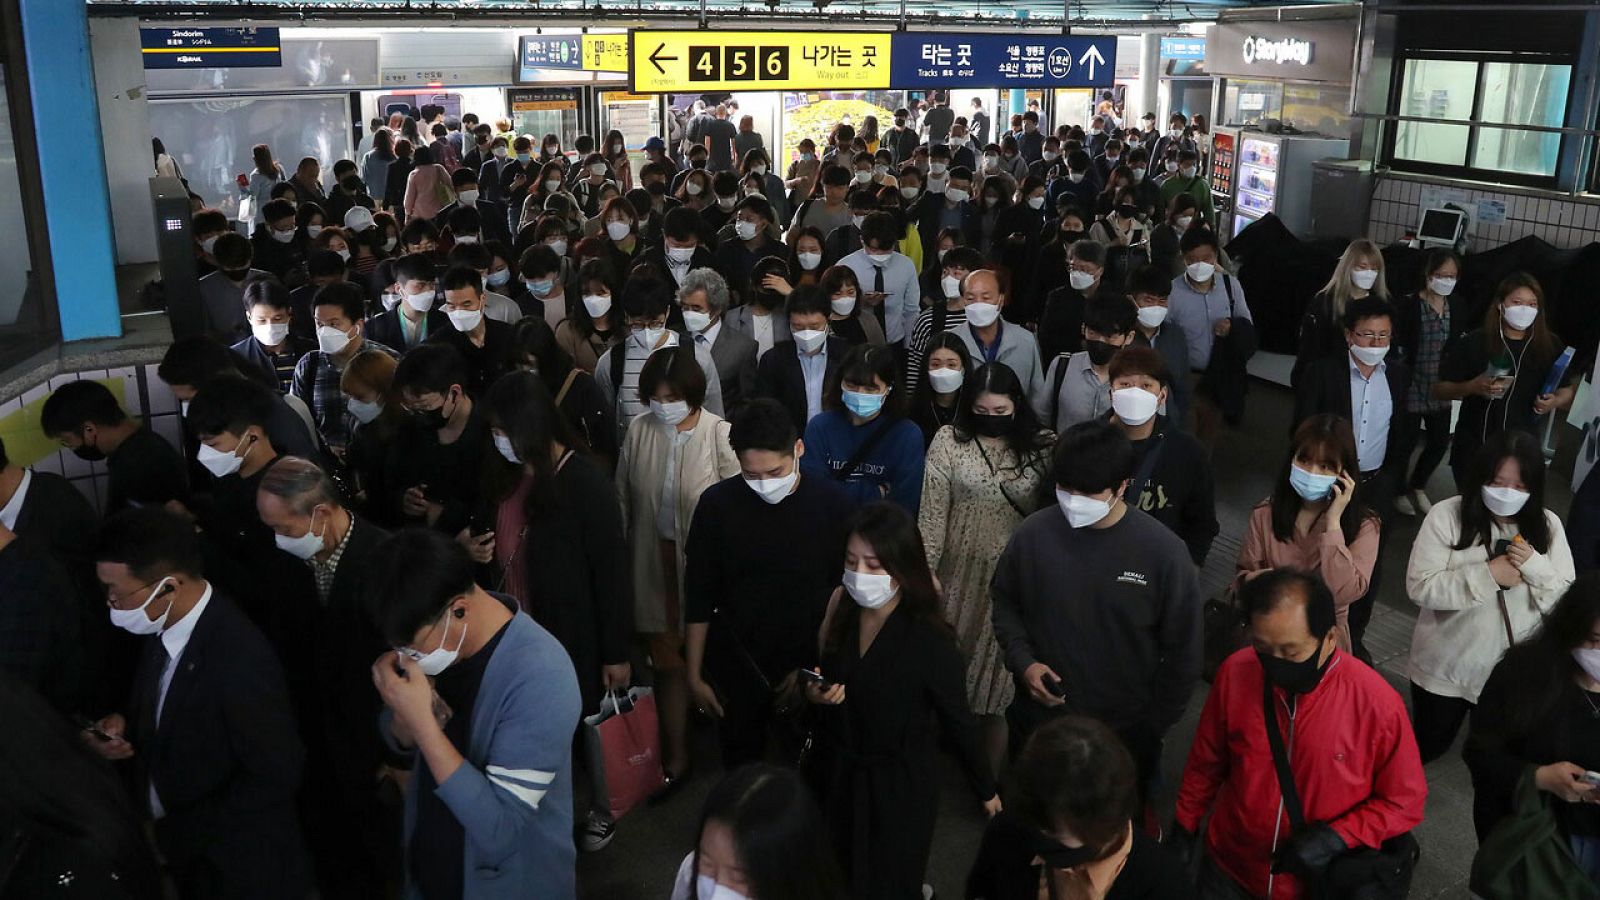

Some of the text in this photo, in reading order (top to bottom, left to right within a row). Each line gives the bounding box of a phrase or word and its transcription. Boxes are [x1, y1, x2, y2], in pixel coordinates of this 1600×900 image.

[803, 45, 877, 67] 나가는 곳
[922, 44, 972, 66] 타는 곳
[1006, 45, 1020, 56] 서울
[696, 50, 782, 76] 4 5 6
[1051, 55, 1070, 66] 1호선
[918, 68, 938, 77] Tracks
[998, 62, 1019, 73] 소요산
[817, 70, 849, 80] Way out
